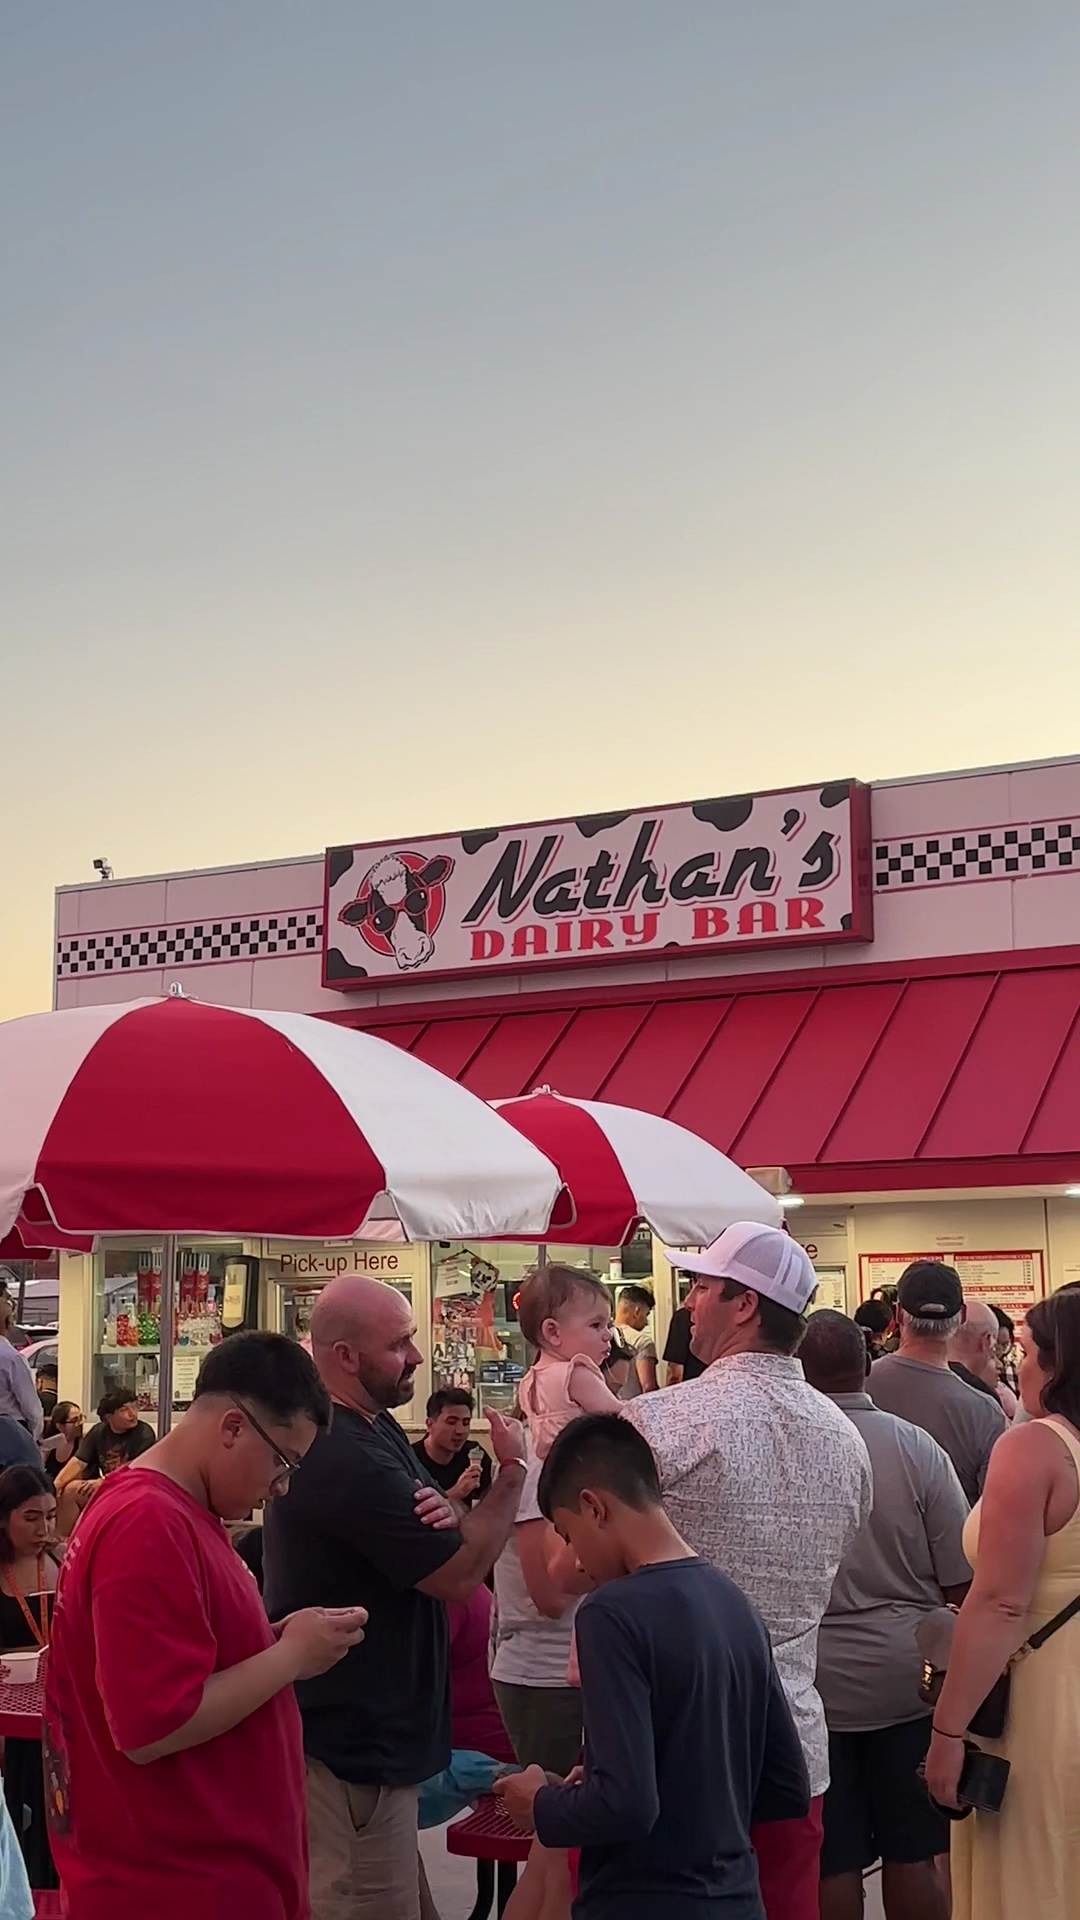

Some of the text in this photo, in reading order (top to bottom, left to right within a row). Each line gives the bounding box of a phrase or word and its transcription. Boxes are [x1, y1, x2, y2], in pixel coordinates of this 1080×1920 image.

[461, 808, 841, 928] Nathan's
[470, 897, 825, 961] DAIRY BAR
[280, 1251, 398, 1276] Pick-up Here
